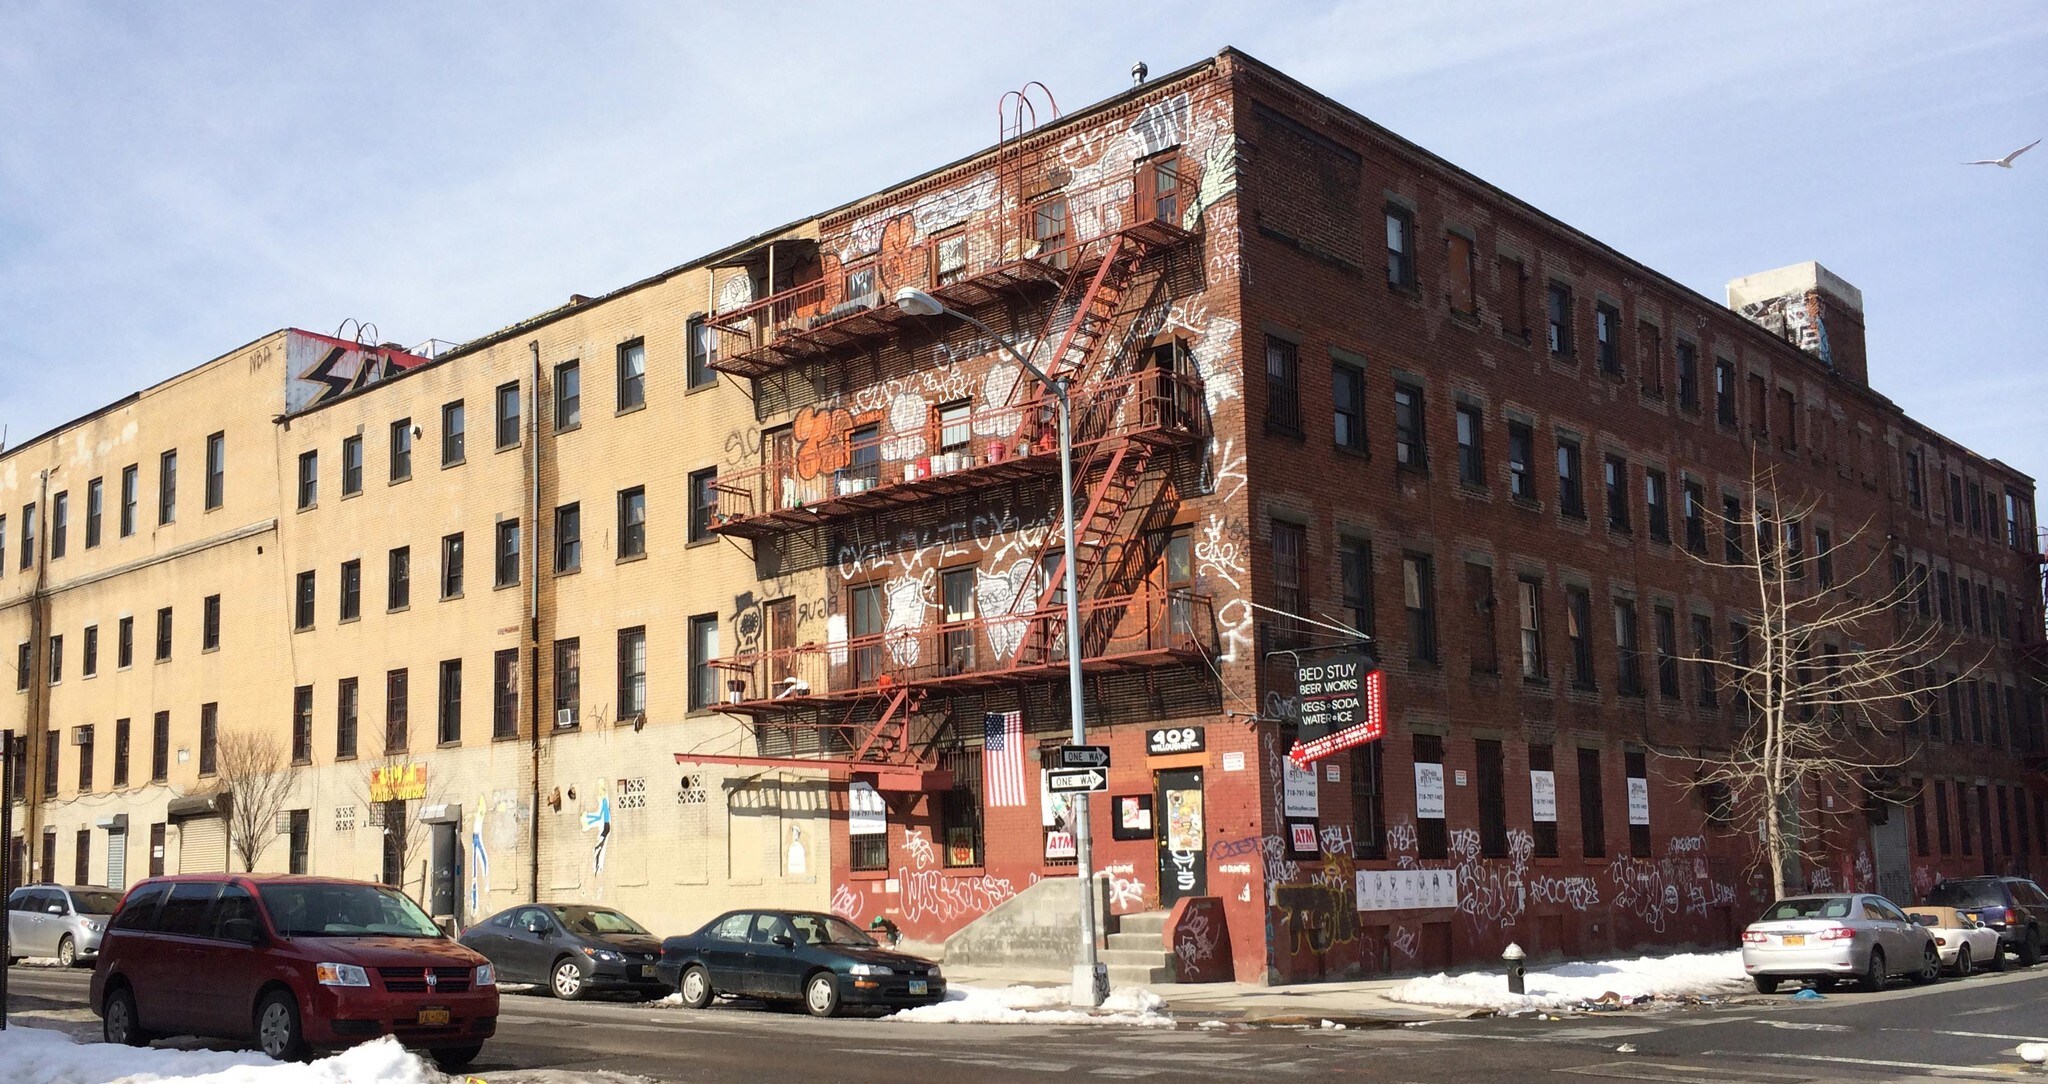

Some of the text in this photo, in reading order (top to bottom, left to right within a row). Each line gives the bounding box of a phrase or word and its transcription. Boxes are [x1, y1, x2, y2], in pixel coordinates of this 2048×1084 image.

[1299, 663, 1357, 682] BED STUY
[1300, 679, 1358, 695] BEER WORKS
[1301, 701, 1326, 713] KEGS
[1332, 698, 1360, 710] SODA
[1302, 711, 1353, 726] WATER ICE
[1152, 728, 1196, 745] 409
[1068, 751, 1103, 761] ONE WAY
[1056, 775, 1098, 787] ONE WAY
[1049, 836, 1074, 850] ATM
[1295, 829, 1315, 844] ATM
